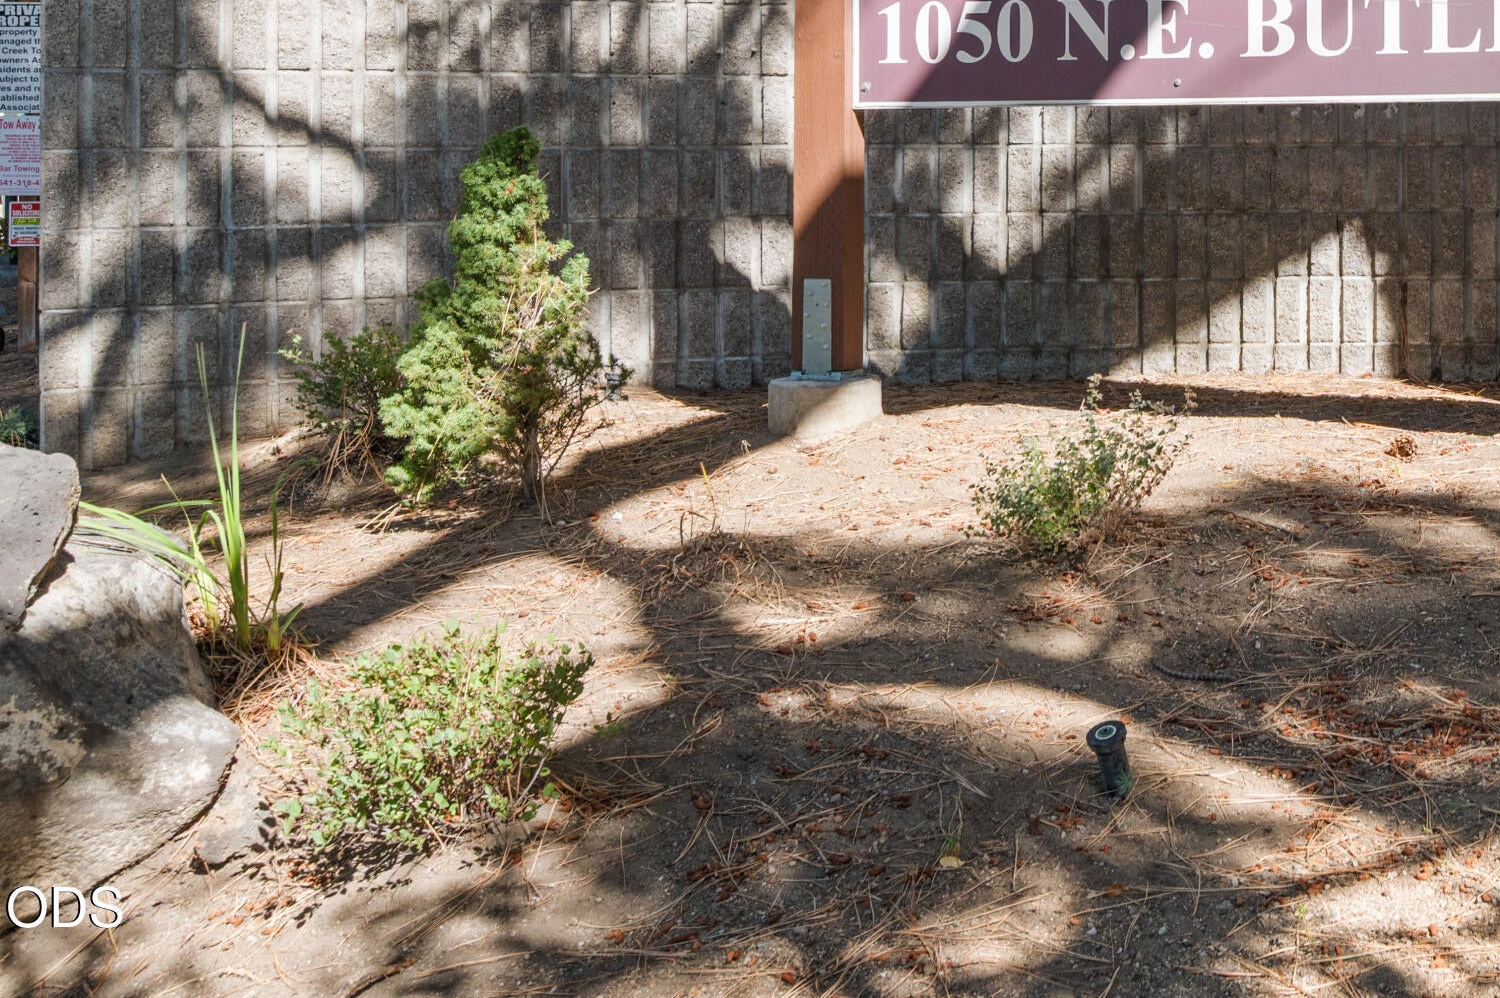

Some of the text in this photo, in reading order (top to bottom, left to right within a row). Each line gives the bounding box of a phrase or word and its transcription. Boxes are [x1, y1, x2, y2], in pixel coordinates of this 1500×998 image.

[0, 29, 37, 37] property
[876, 0, 1034, 65] 1050
[0, 119, 14, 129] Tow
[16, 118, 36, 132] Away
[14, 165, 40, 173] Towing
